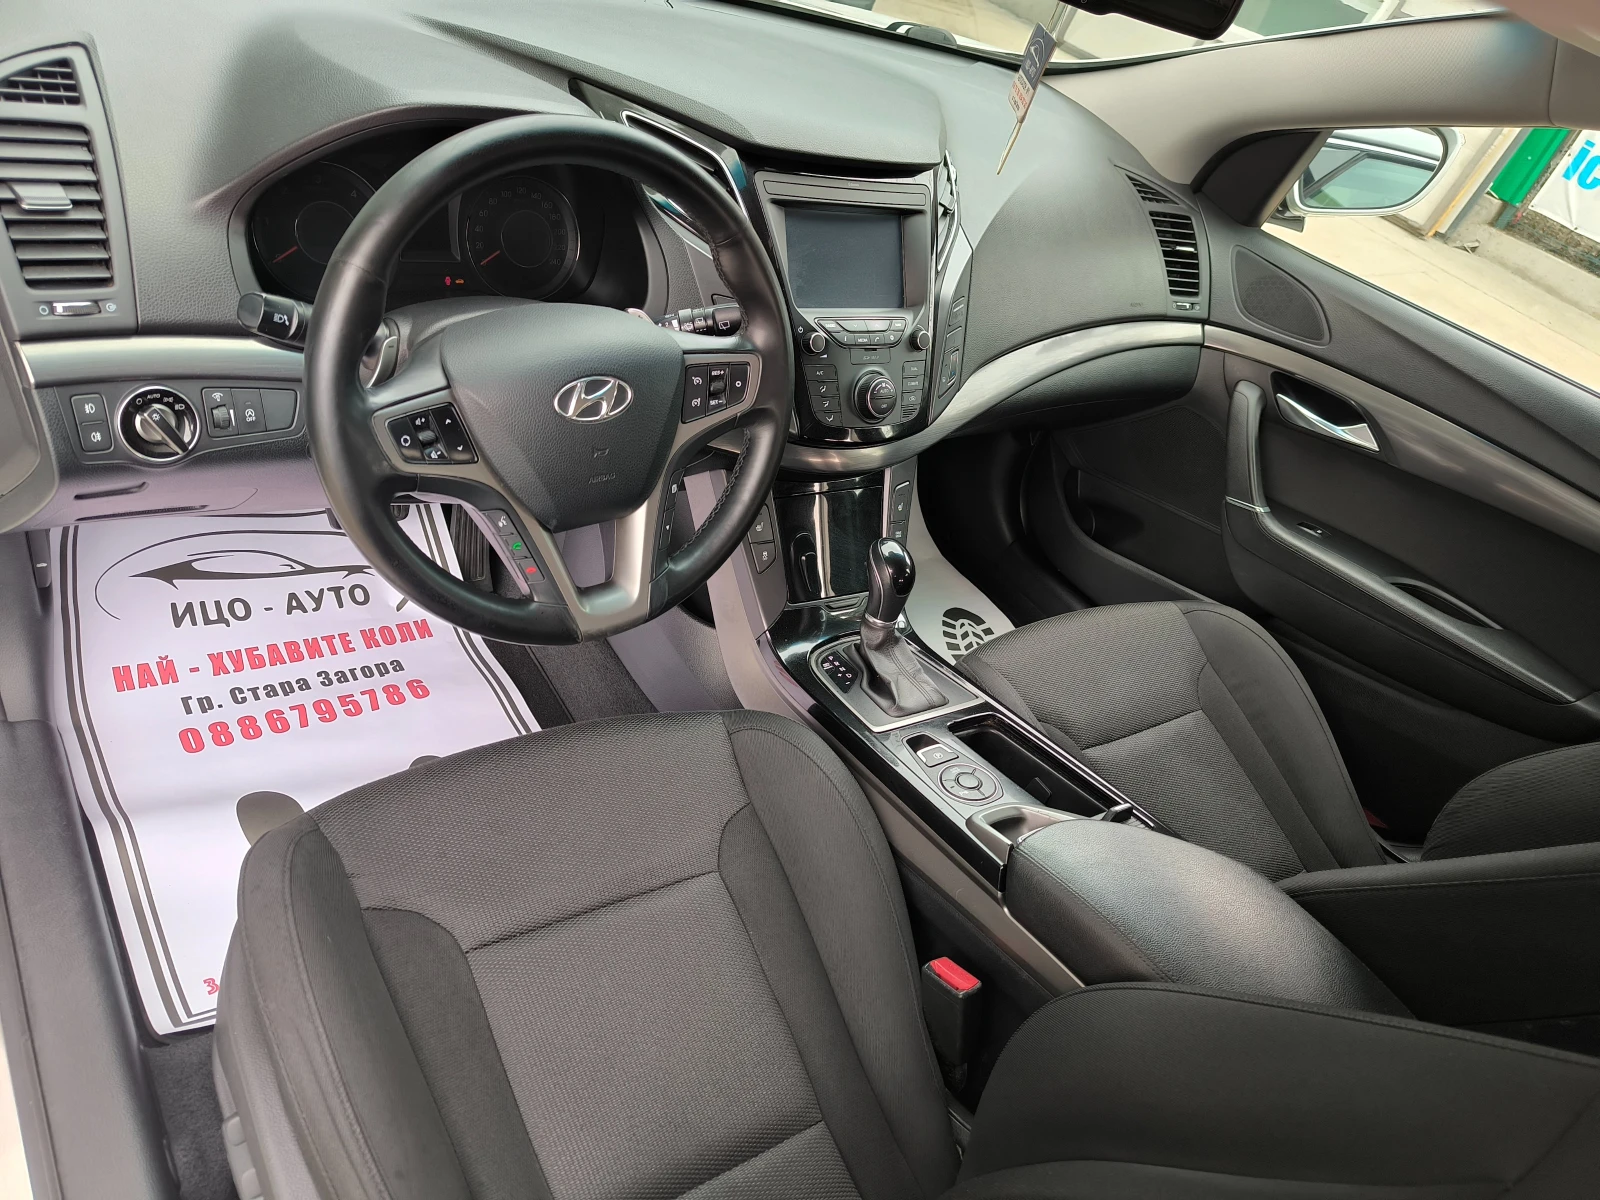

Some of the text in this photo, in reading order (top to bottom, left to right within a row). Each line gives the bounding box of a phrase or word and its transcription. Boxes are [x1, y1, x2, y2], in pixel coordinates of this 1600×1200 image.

[350, 189, 357, 198] 4
[501, 190, 511, 198] 100
[516, 186, 526, 194] 120
[531, 192, 542, 200] 140
[488, 197, 498, 205] 80
[541, 201, 553, 209] 160
[478, 209, 488, 217] 60
[475, 241, 485, 249] 20
[170, 597, 252, 629] ИЦО
[286, 583, 371, 616] АУТО
[112, 655, 179, 693] НАЙ
[207, 632, 356, 677] ХУБАВИТЕ
[360, 618, 434, 650] КОЛИ
[180, 659, 406, 715] Гр. Стара Загора
[178, 678, 431, 754] 0886795786
